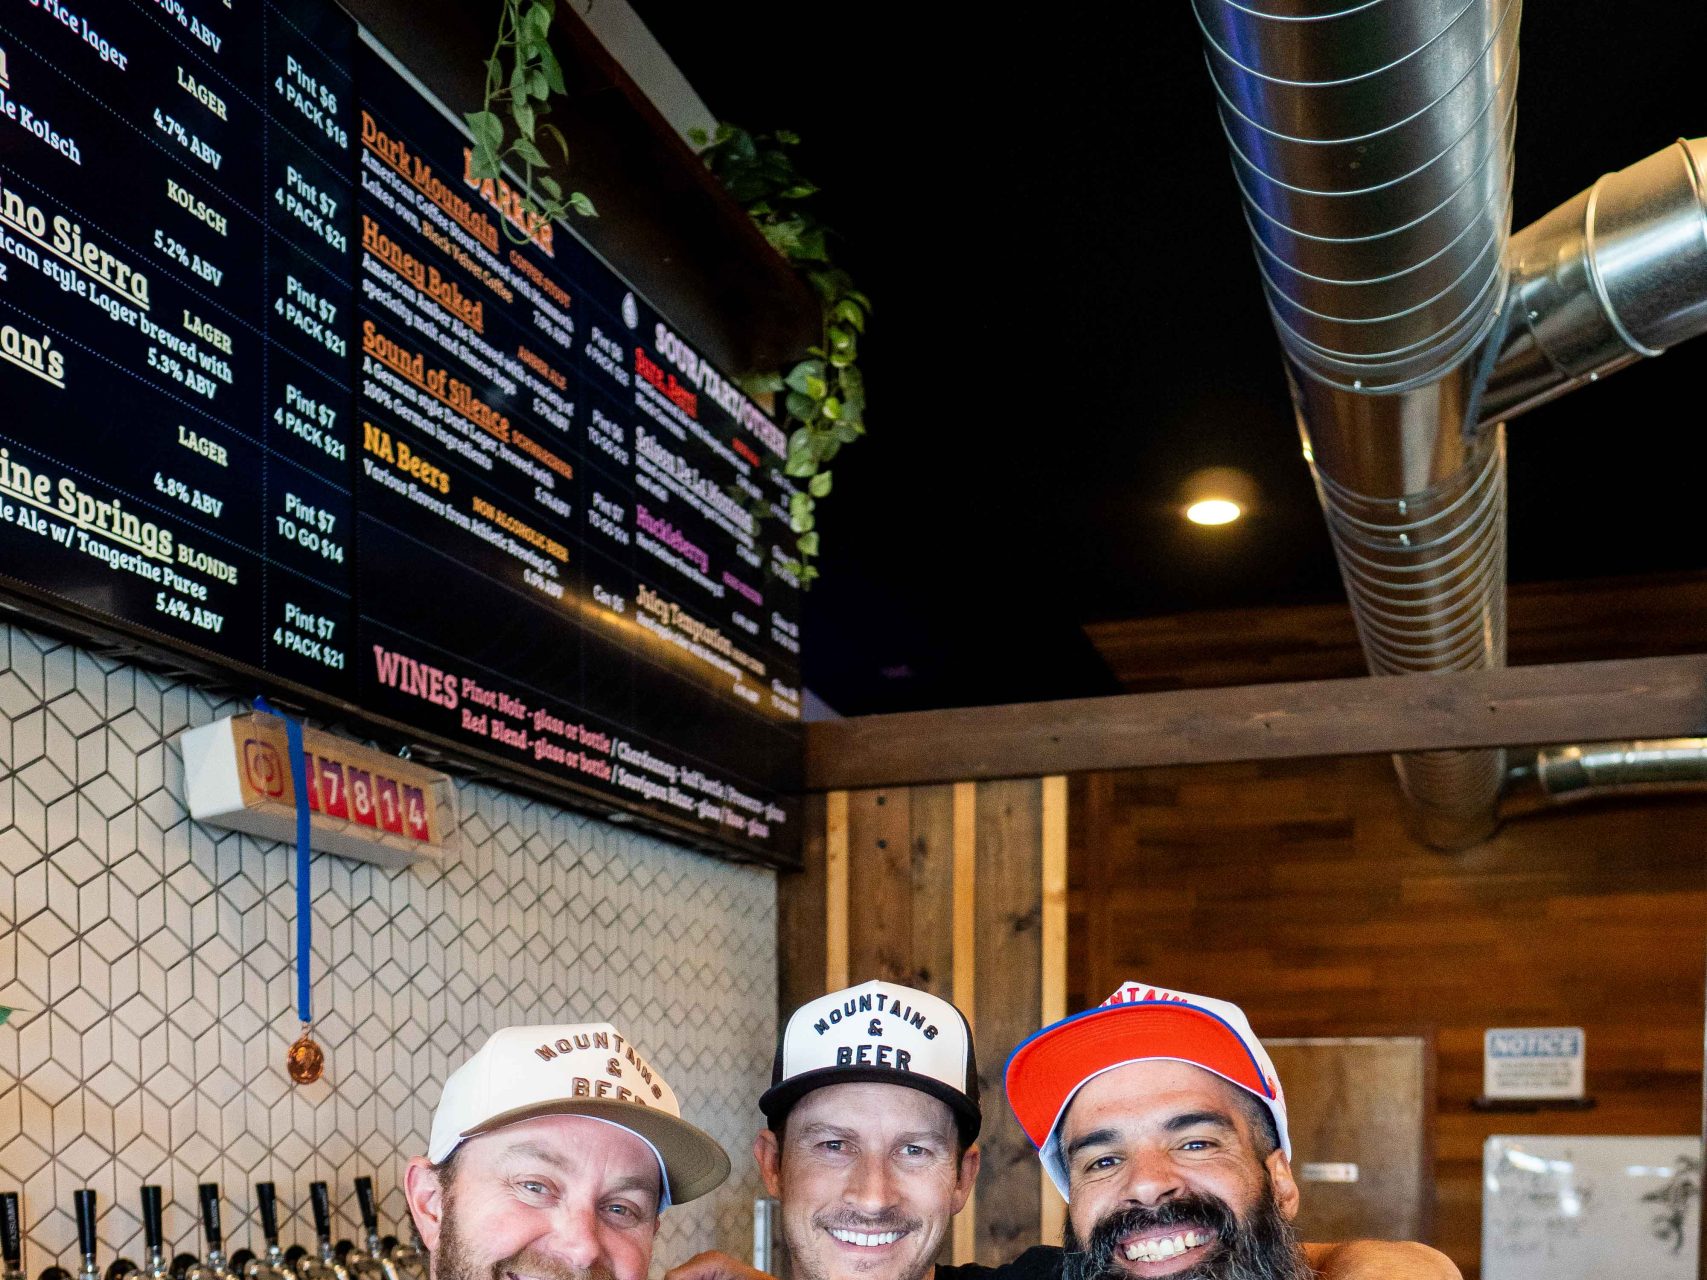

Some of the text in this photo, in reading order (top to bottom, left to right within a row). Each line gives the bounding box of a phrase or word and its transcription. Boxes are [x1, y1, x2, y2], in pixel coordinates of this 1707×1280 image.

[82, 18, 128, 71] lager
[190, 16, 221, 53] ABV
[177, 66, 227, 121] LAGER
[274, 76, 284, 94] 4
[286, 84, 323, 129] PACK
[286, 55, 317, 97] Pint
[20, 105, 81, 165] Kolsch
[153, 108, 222, 170] 4.7% ABV
[167, 178, 227, 236] KOLSCH
[286, 165, 337, 219] Pint $7
[361, 110, 499, 252] Dark Mountain
[274, 187, 347, 253] 4 PACK $21
[53, 214, 149, 302] Sierra
[154, 229, 223, 287] 5.2% ABV
[362, 216, 483, 330] Honey Baked
[43, 257, 86, 296] style
[89, 282, 137, 329] Lager
[140, 313, 196, 362] brewed
[197, 350, 233, 384] with
[286, 275, 337, 324] Pint $7
[183, 309, 233, 354] LAGER
[274, 298, 347, 357] 4 PACK $21
[147, 347, 217, 400] 5.3% ABV
[363, 320, 509, 441] Sound of Silence
[285, 384, 336, 429] Pint $7
[178, 425, 228, 467] LAGER
[273, 407, 346, 461] 4 PACK $21
[363, 422, 449, 493] NA Beers
[153, 472, 223, 518] 4.8% ABV
[285, 493, 336, 534] Pint $7
[17, 507, 207, 601] Ale w/ Tangerine Puree
[58, 478, 238, 585] Springs BLONDE
[275, 515, 344, 564] TO GO $14
[192, 606, 224, 633] ABV
[285, 603, 335, 640] Pint $7
[273, 627, 345, 669] 4 PACK $21
[373, 645, 458, 710] WINES
[461, 678, 497, 709] Pinot
[498, 692, 526, 719] Noir
[461, 708, 487, 735] Red
[491, 719, 527, 749] Blend
[813, 993, 939, 1041] MOUNTAINS
[867, 1018, 883, 1037] &
[534, 1031, 662, 1100] MOUNTAINS
[606, 1057, 622, 1078] &
[836, 1045, 912, 1071] BEER
